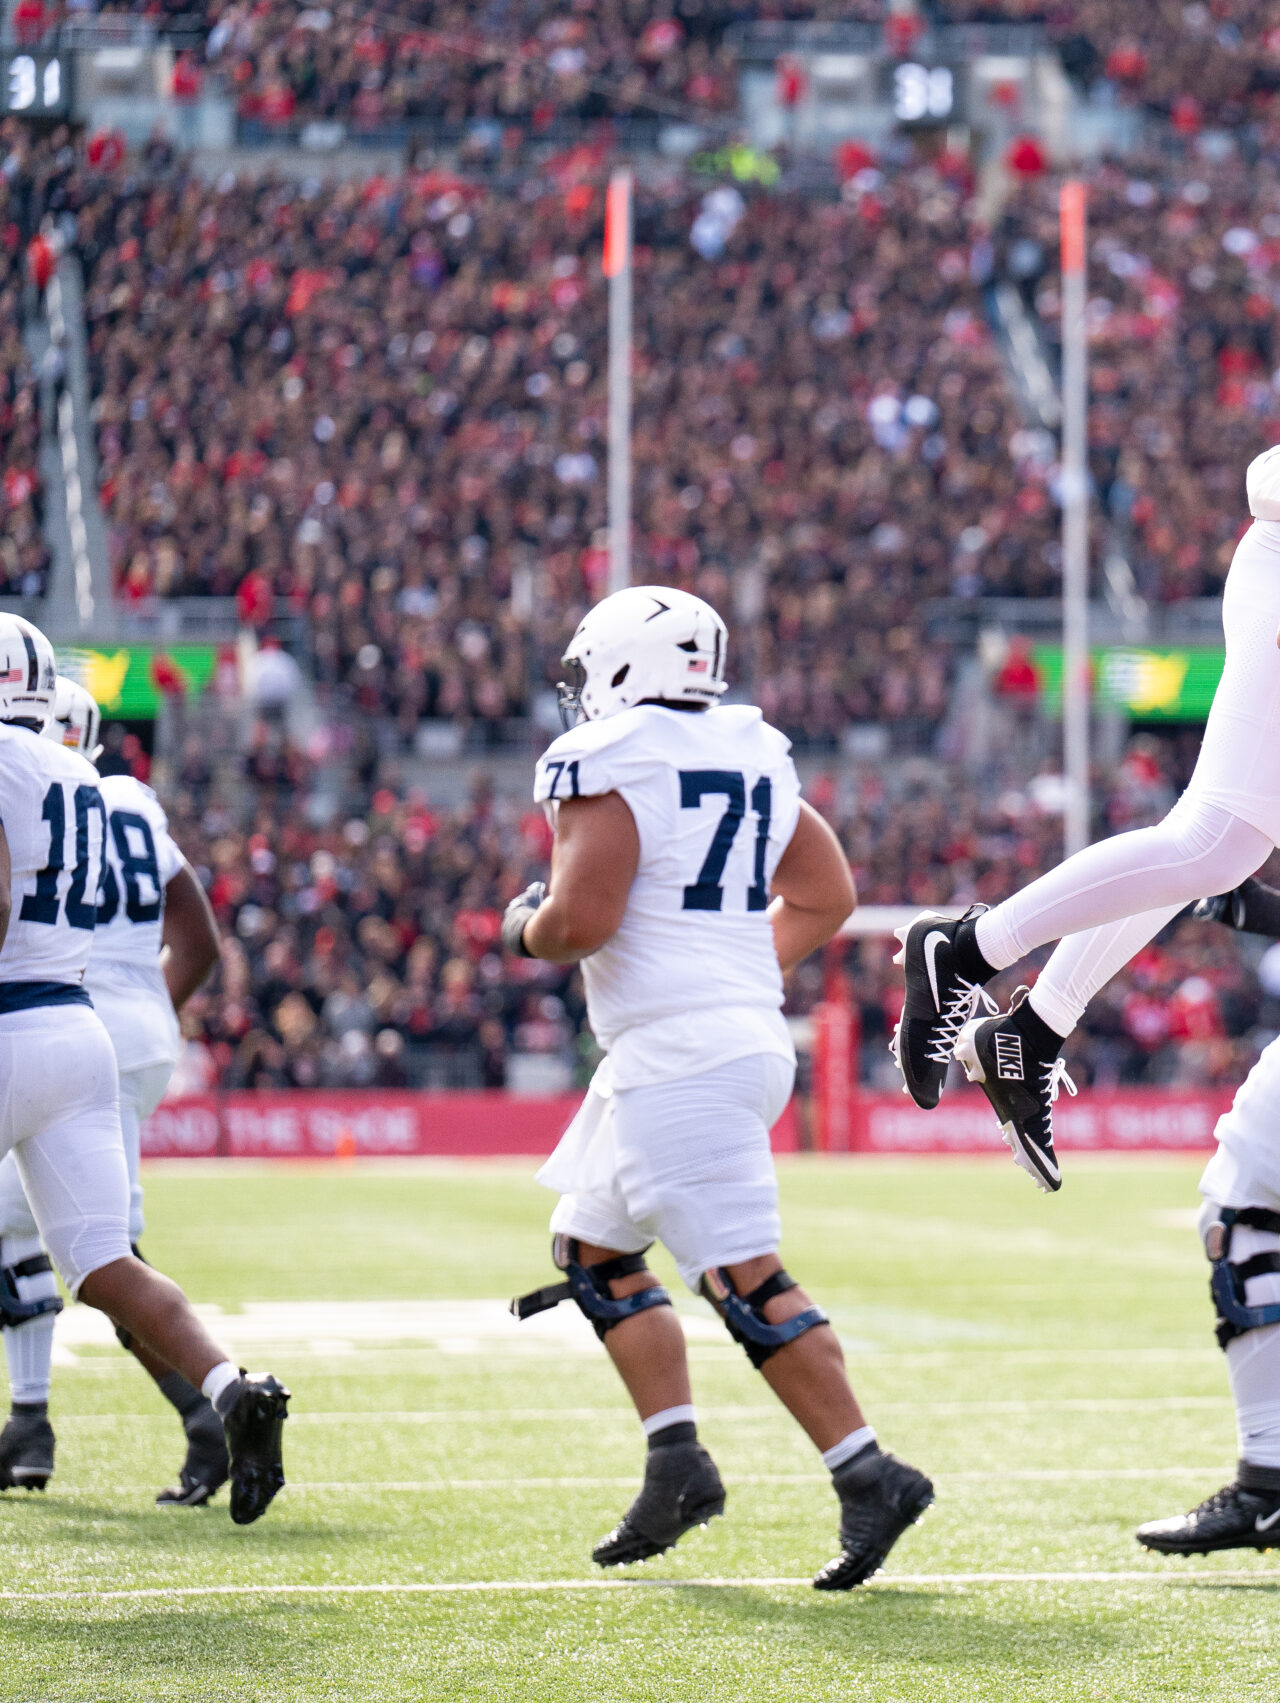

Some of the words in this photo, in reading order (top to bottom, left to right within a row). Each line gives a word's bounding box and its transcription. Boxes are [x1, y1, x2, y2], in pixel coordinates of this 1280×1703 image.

[8, 54, 61, 110] 31
[545, 760, 580, 801] 71
[18, 782, 108, 932] 10
[678, 769, 772, 912] 71
[996, 1033, 1024, 1080] NIKE
